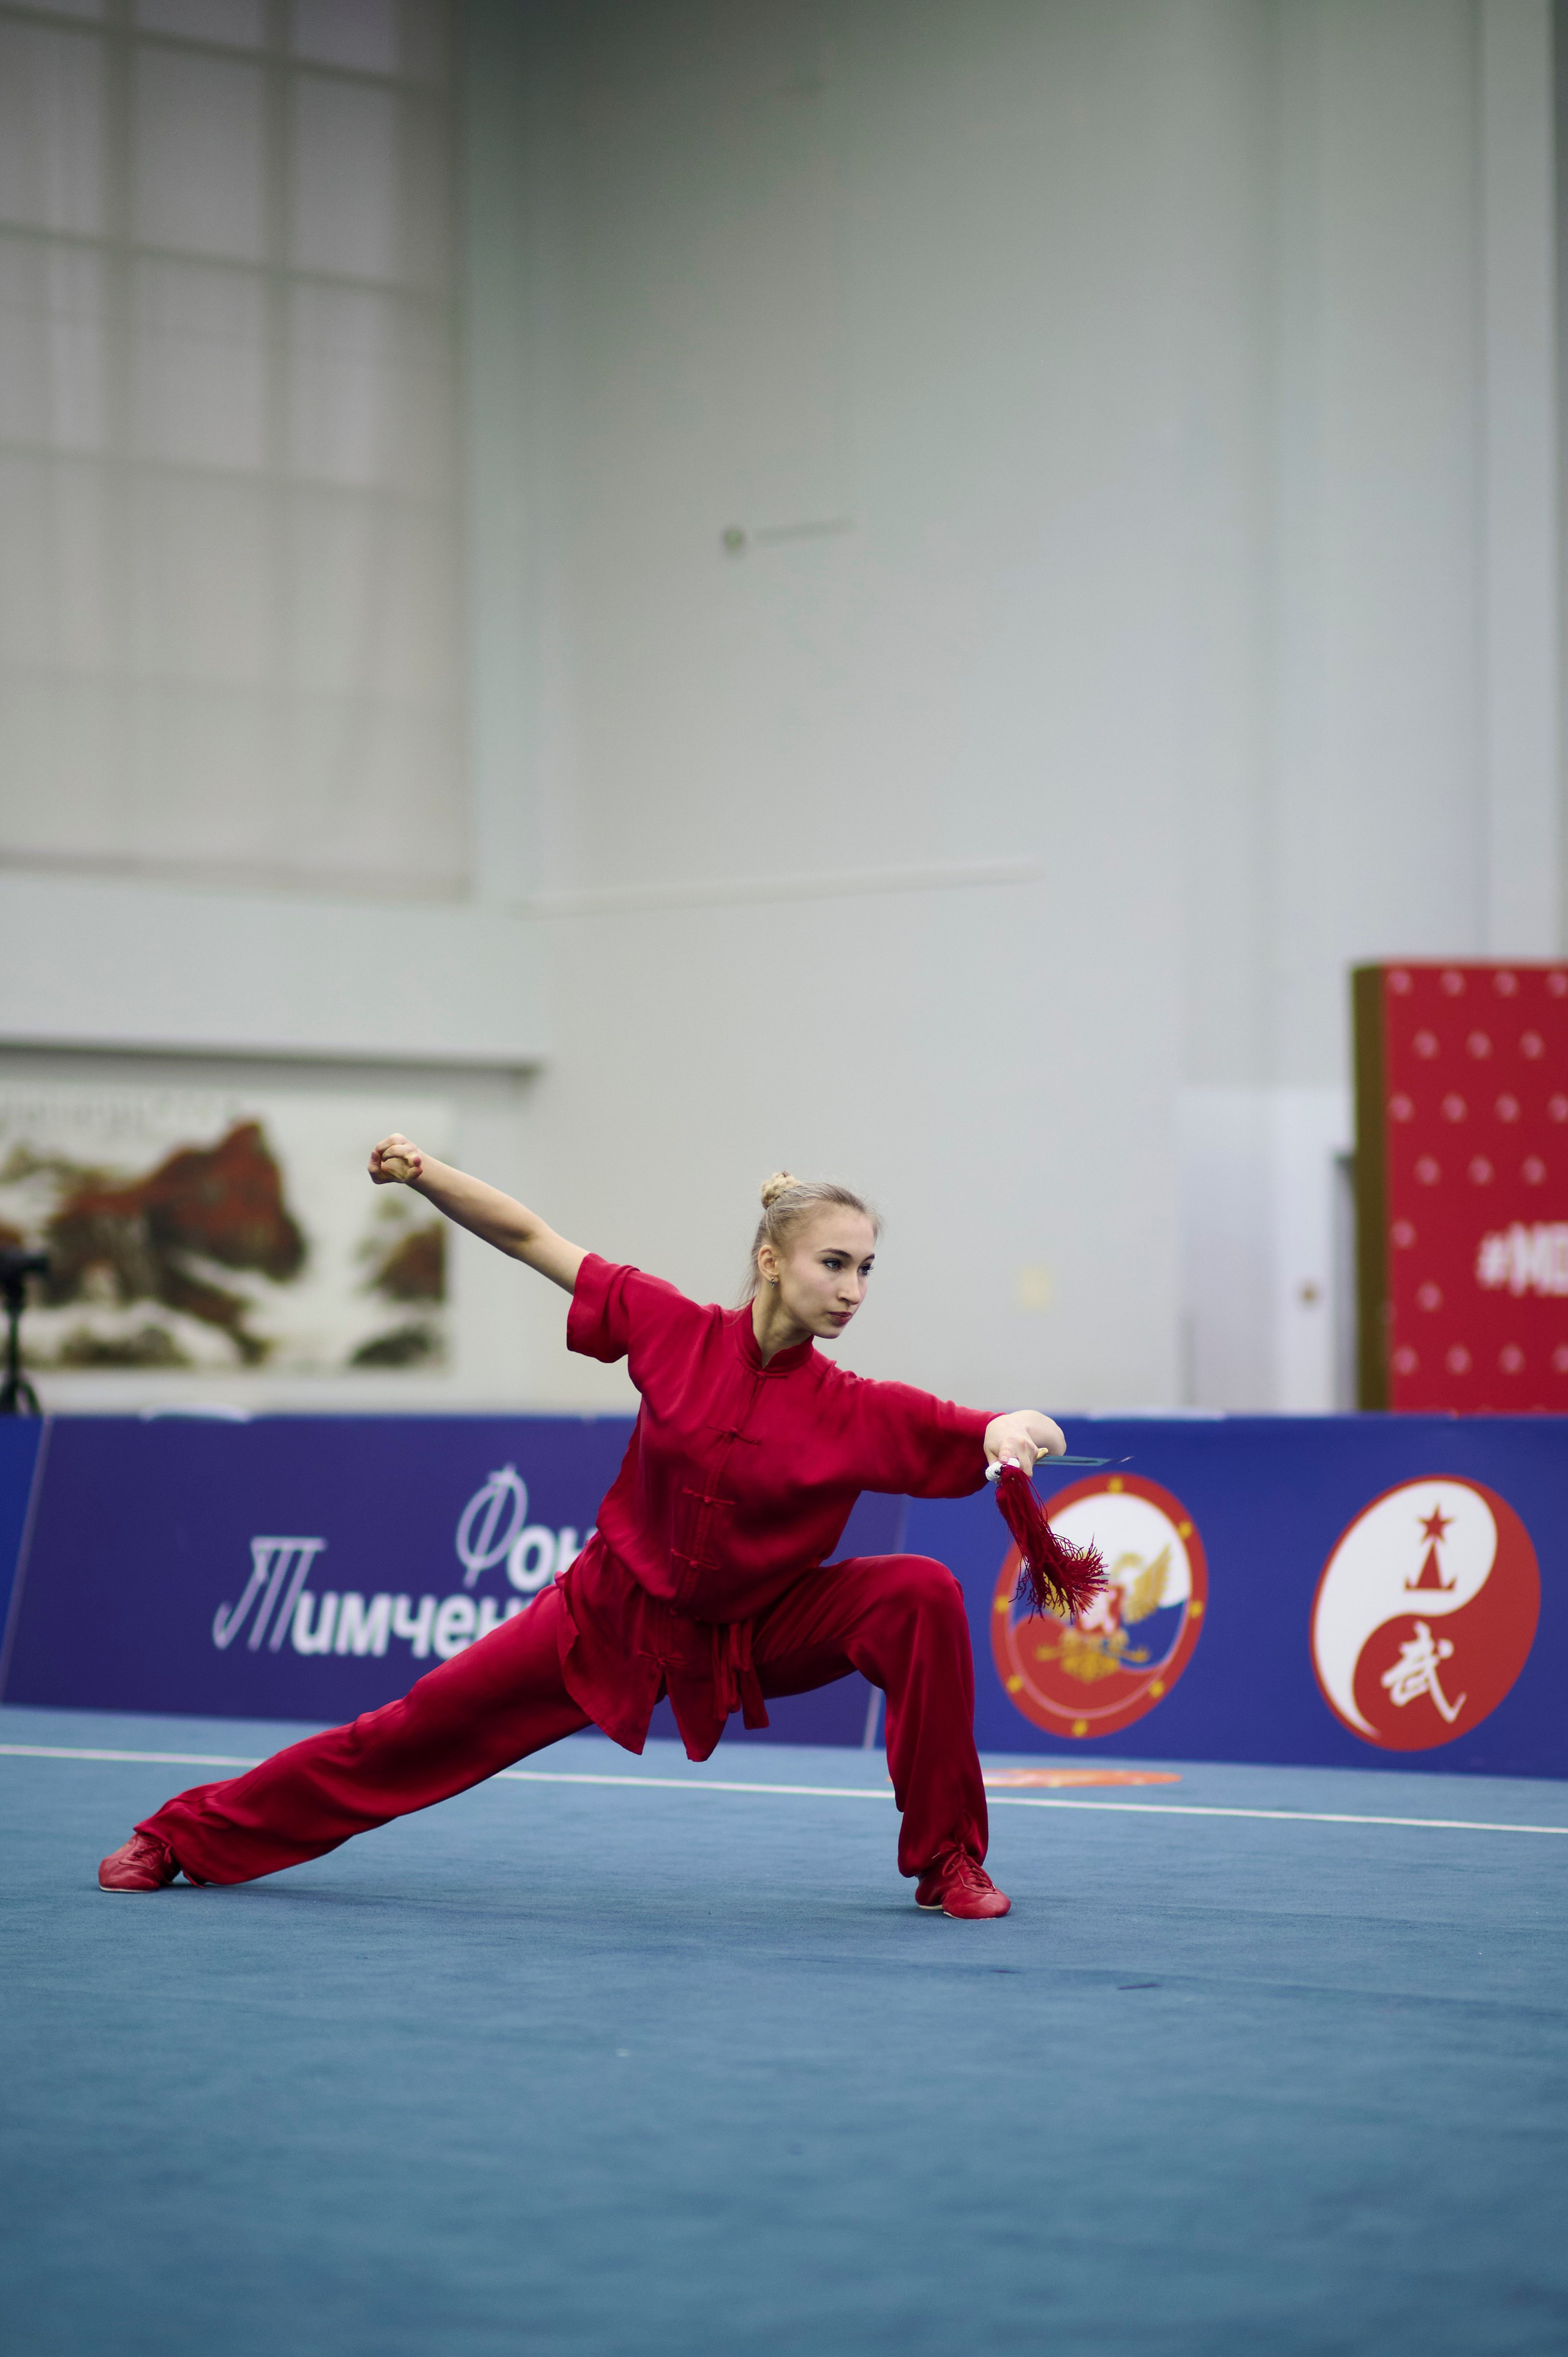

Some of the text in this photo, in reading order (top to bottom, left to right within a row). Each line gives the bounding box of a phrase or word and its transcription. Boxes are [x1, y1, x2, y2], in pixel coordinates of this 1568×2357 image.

[455, 1461, 599, 1592] Фон
[212, 1536, 533, 1661] Тимчен
[1381, 1620, 1467, 1724] 武
